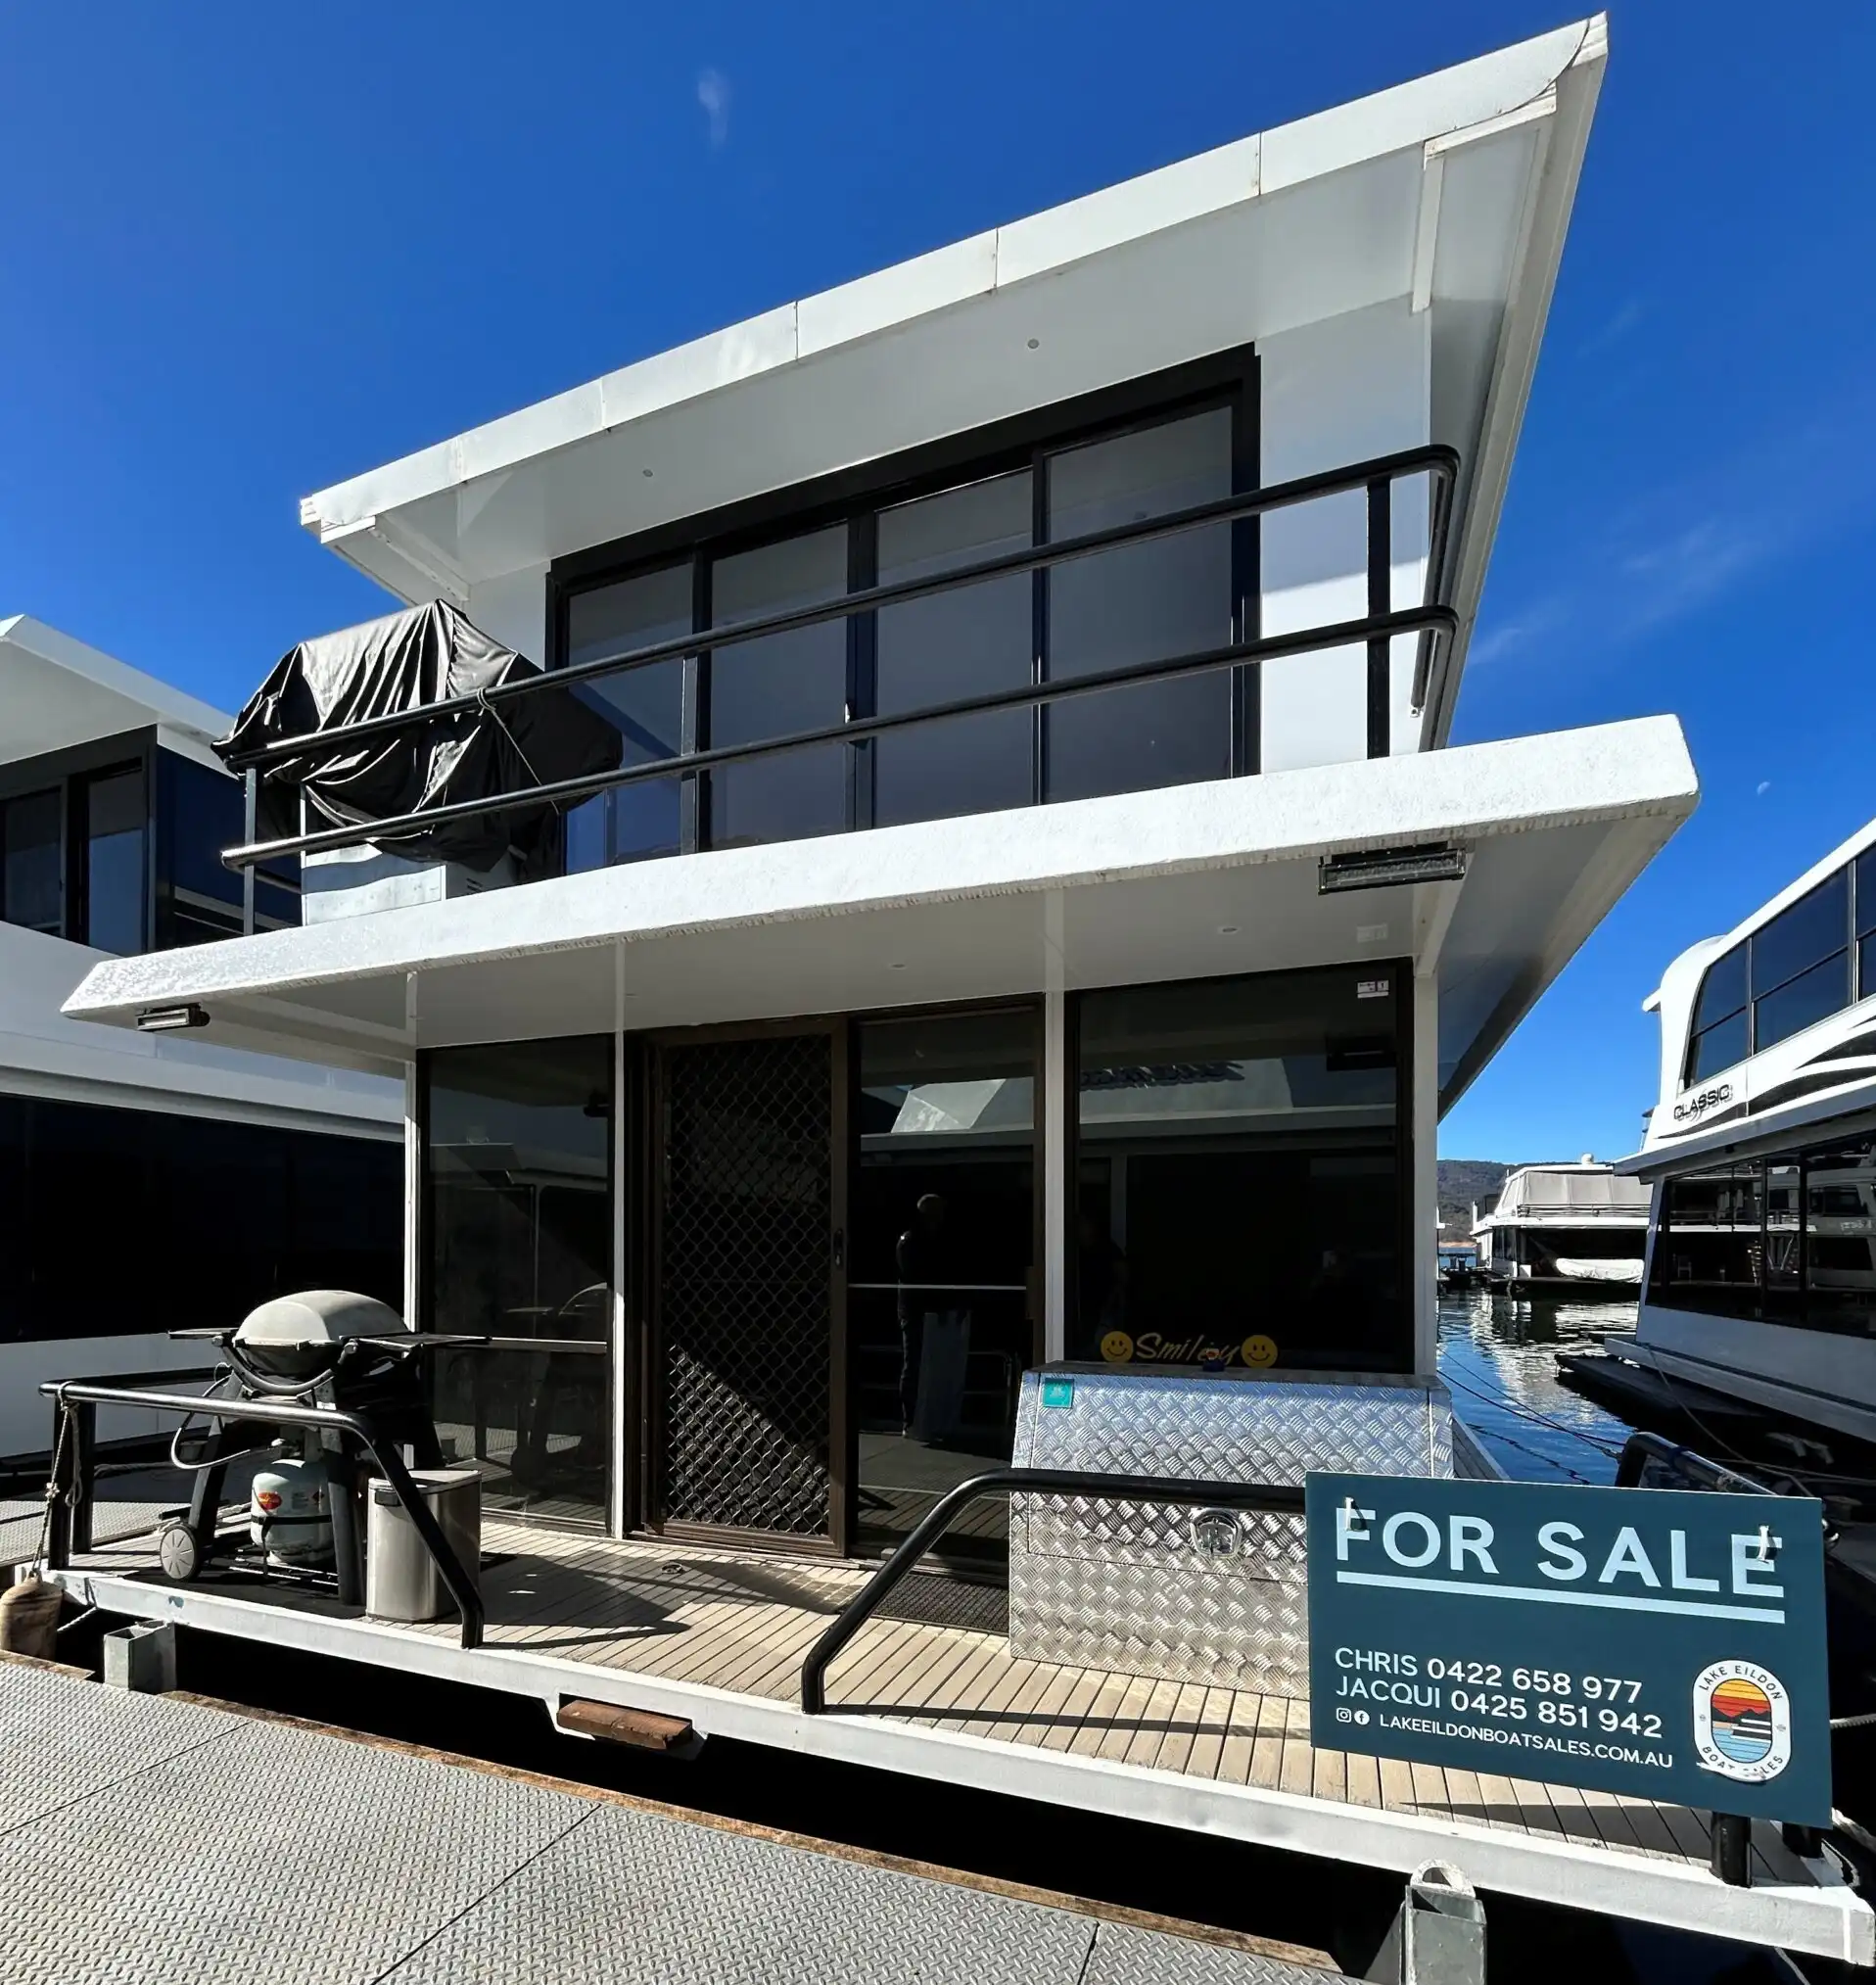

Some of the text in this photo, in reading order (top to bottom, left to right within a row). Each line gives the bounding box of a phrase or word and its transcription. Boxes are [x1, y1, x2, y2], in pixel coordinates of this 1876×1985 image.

[1672, 1084, 1732, 1120] CLASSIC
[1336, 1507, 1785, 1598] FOR SALE
[1335, 1647, 1643, 1704] CHRIS 0422 658 977
[1699, 1665, 1783, 1700] LAKE EILDON
[1336, 1676, 1663, 1739] JACQUI 0425 851 942
[1380, 1714, 1673, 1769] LAKEEILDONBOATSALES.COM.AU
[1743, 1755, 1784, 1777] LES
